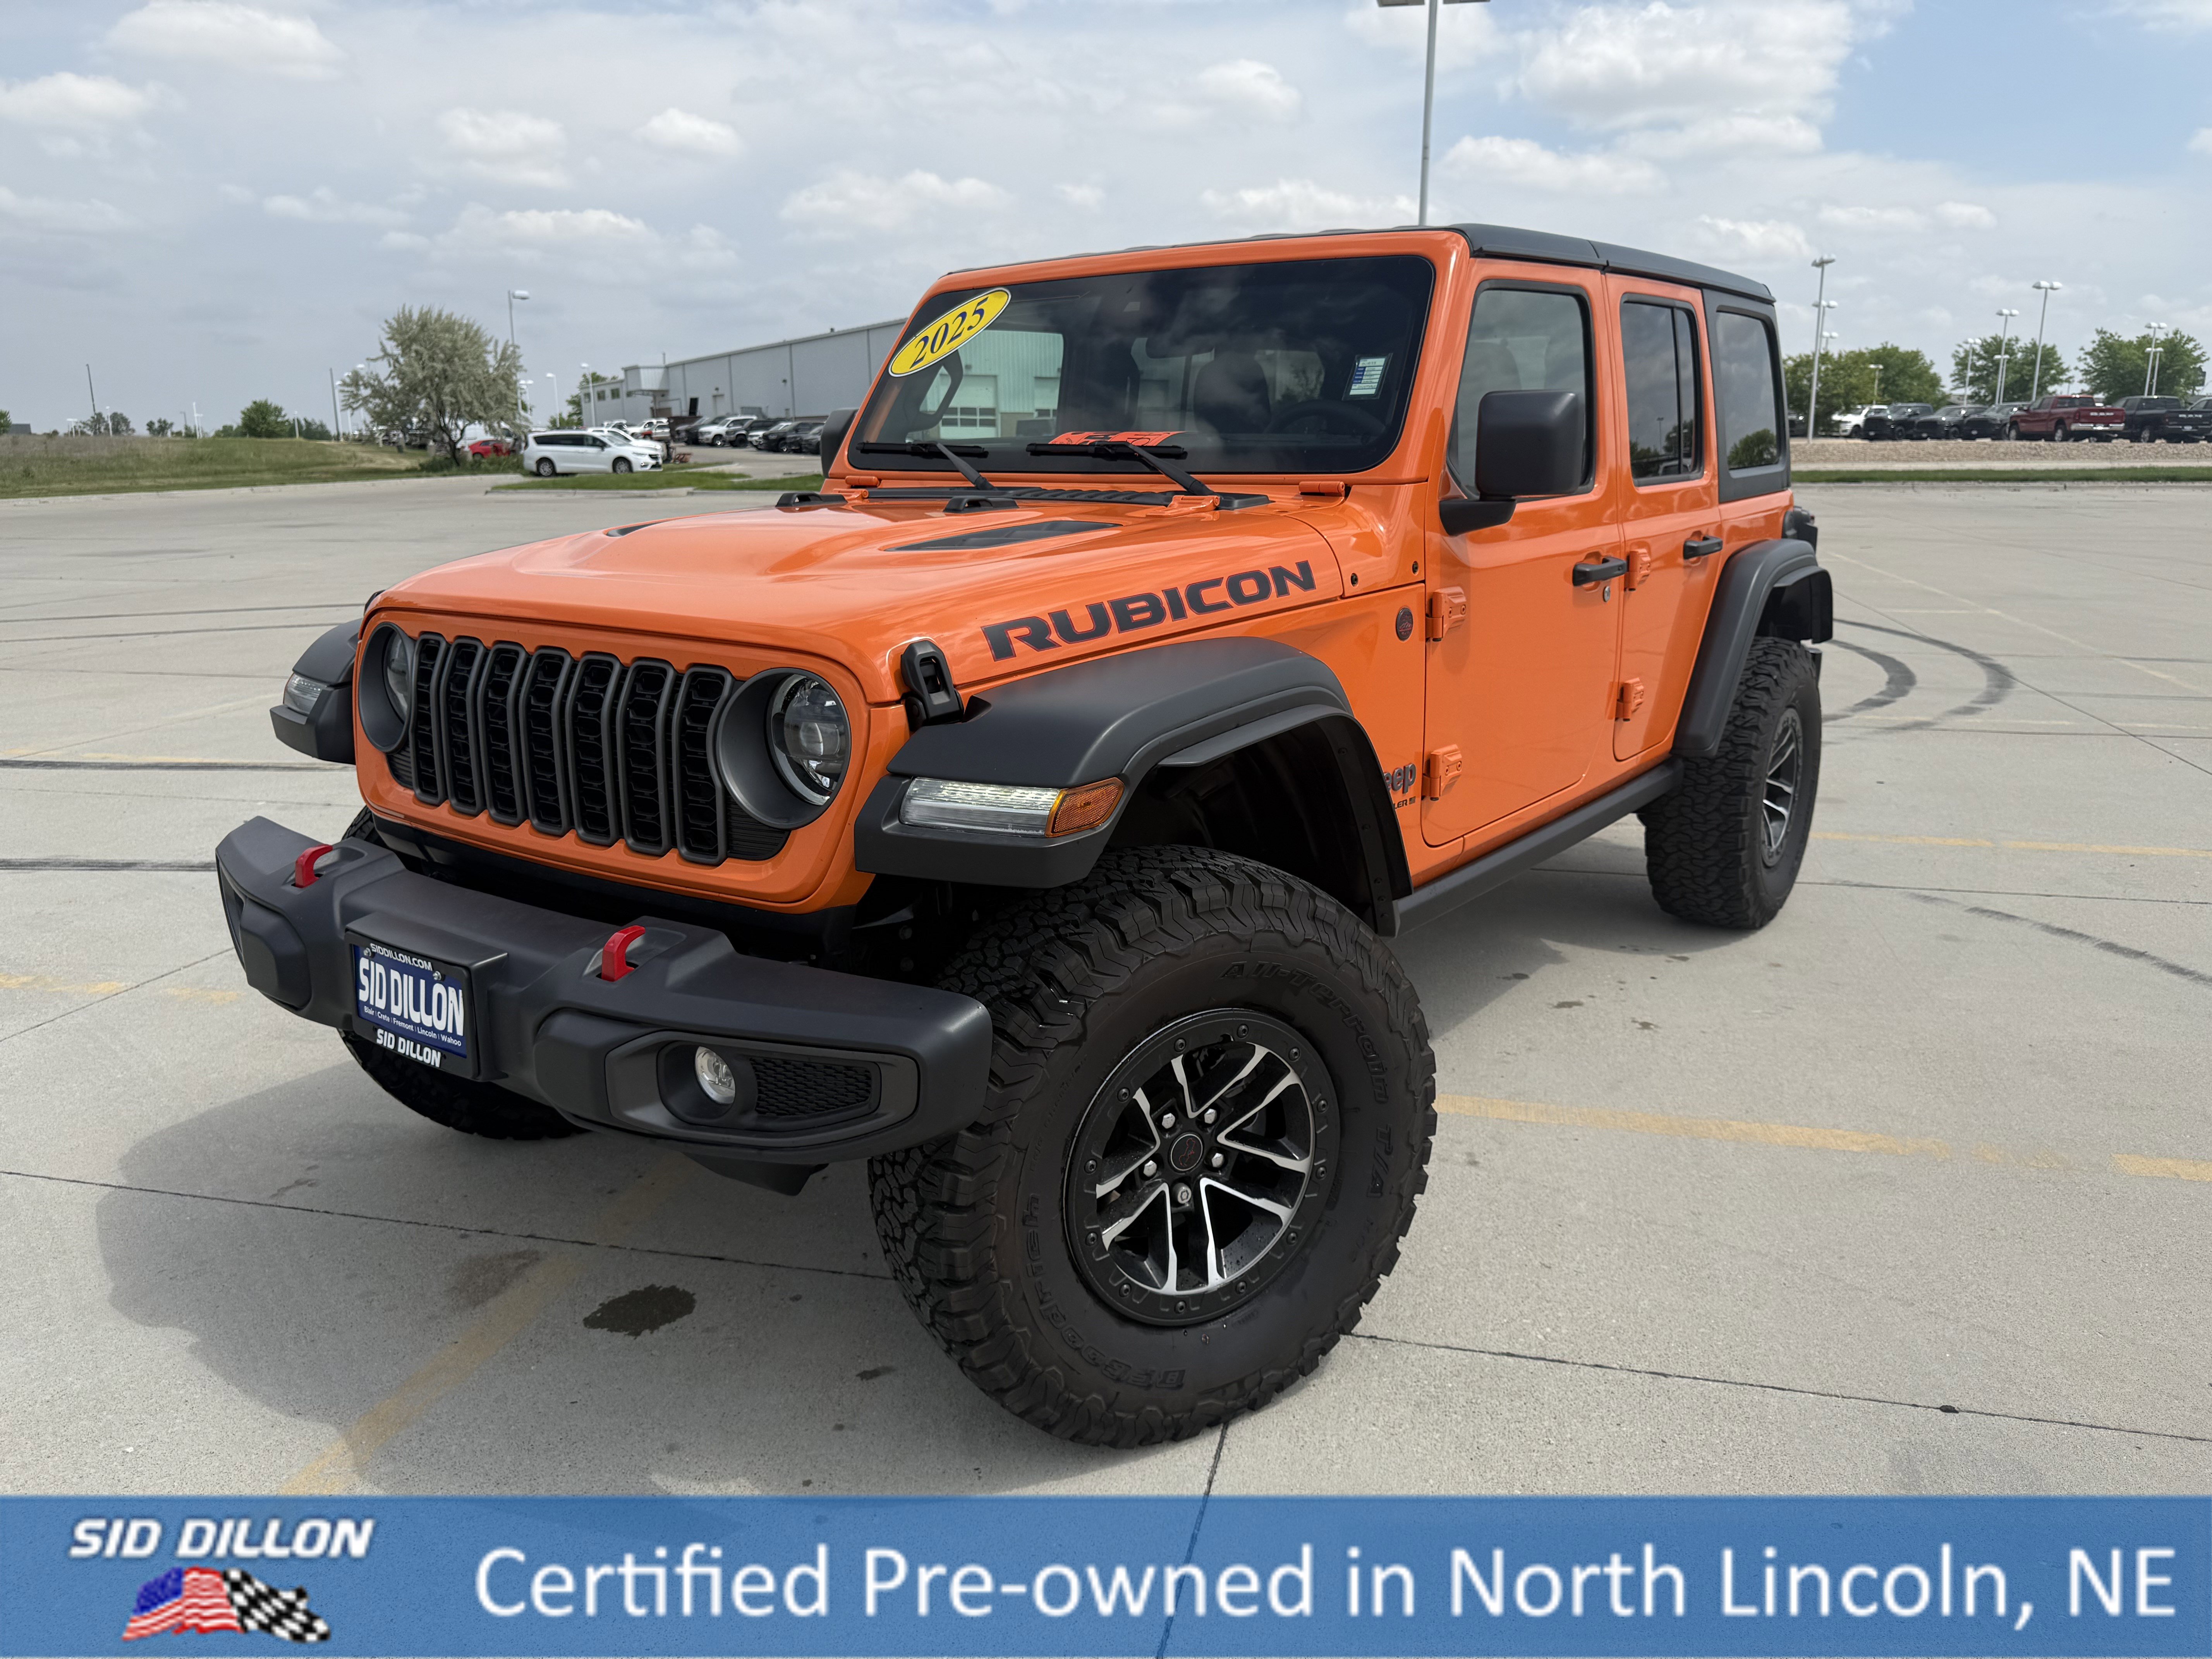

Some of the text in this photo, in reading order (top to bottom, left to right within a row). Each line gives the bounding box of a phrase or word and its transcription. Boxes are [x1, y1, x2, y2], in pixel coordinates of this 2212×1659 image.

[909, 296, 989, 369] 2025
[980, 560, 1316, 662] RUBICON
[1383, 763, 1416, 794] eep
[370, 943, 433, 971] SIDDILLON.COM
[359, 957, 464, 1036] SID DILLON
[364, 1005, 462, 1047] Blair Crete Fremont Lincoln Wahoo
[376, 1028, 442, 1068] SID DILLON
[1366, 1123, 1393, 1198] T/A
